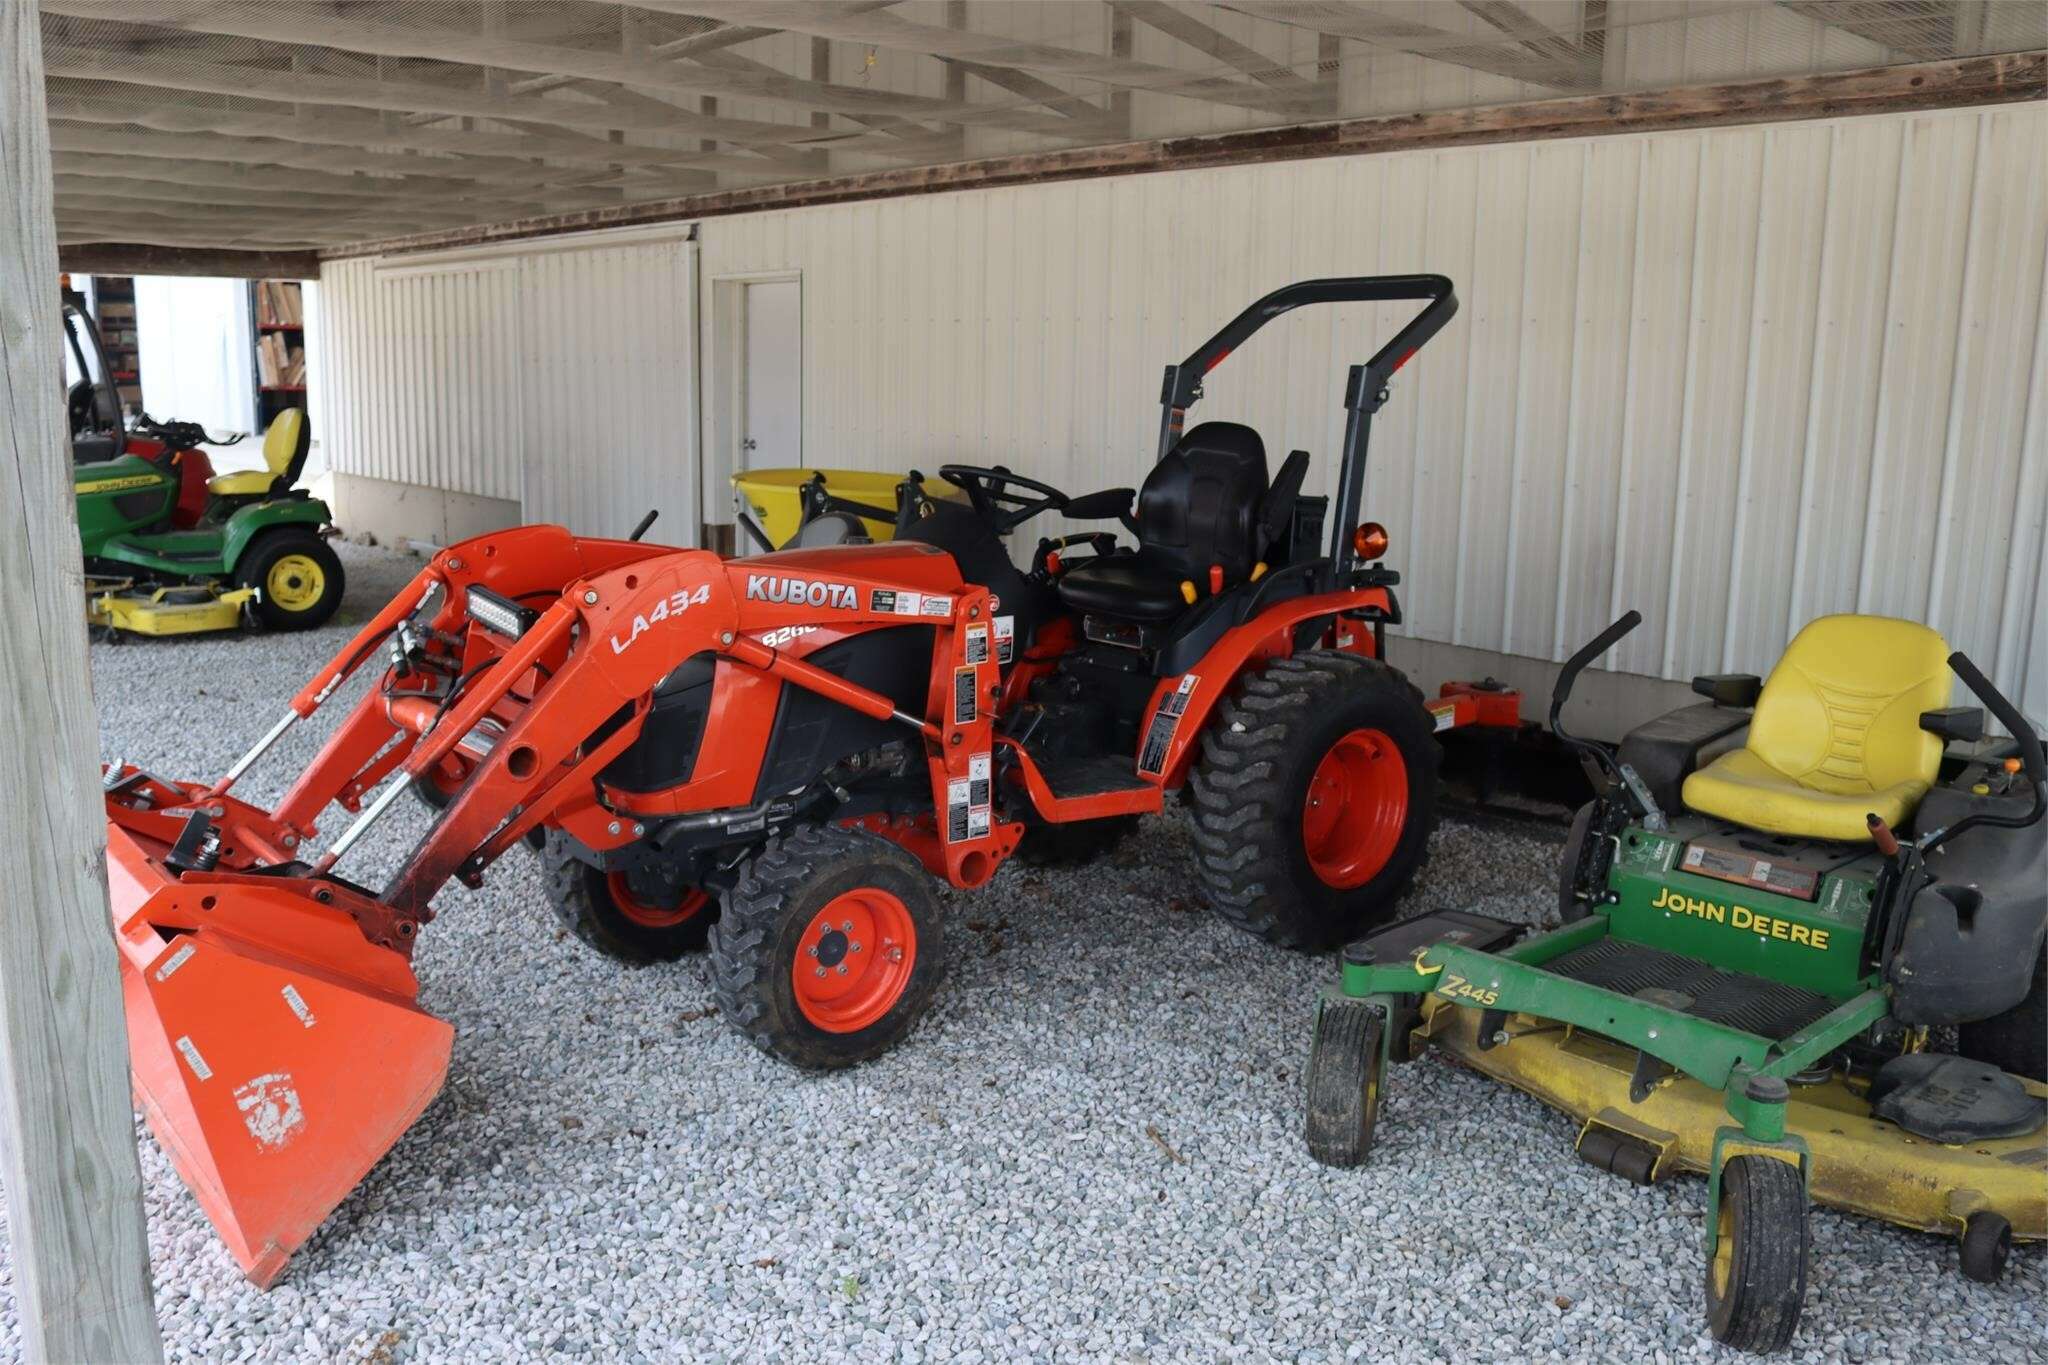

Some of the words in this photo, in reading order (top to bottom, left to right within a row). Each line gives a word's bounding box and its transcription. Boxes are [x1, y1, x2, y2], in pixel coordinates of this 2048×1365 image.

[747, 574, 859, 610] KUBOTA
[610, 584, 710, 655] LA434
[1652, 887, 1726, 923] JOHN
[1731, 905, 1830, 950] DEERE
[1438, 974, 1498, 1005] Z445
